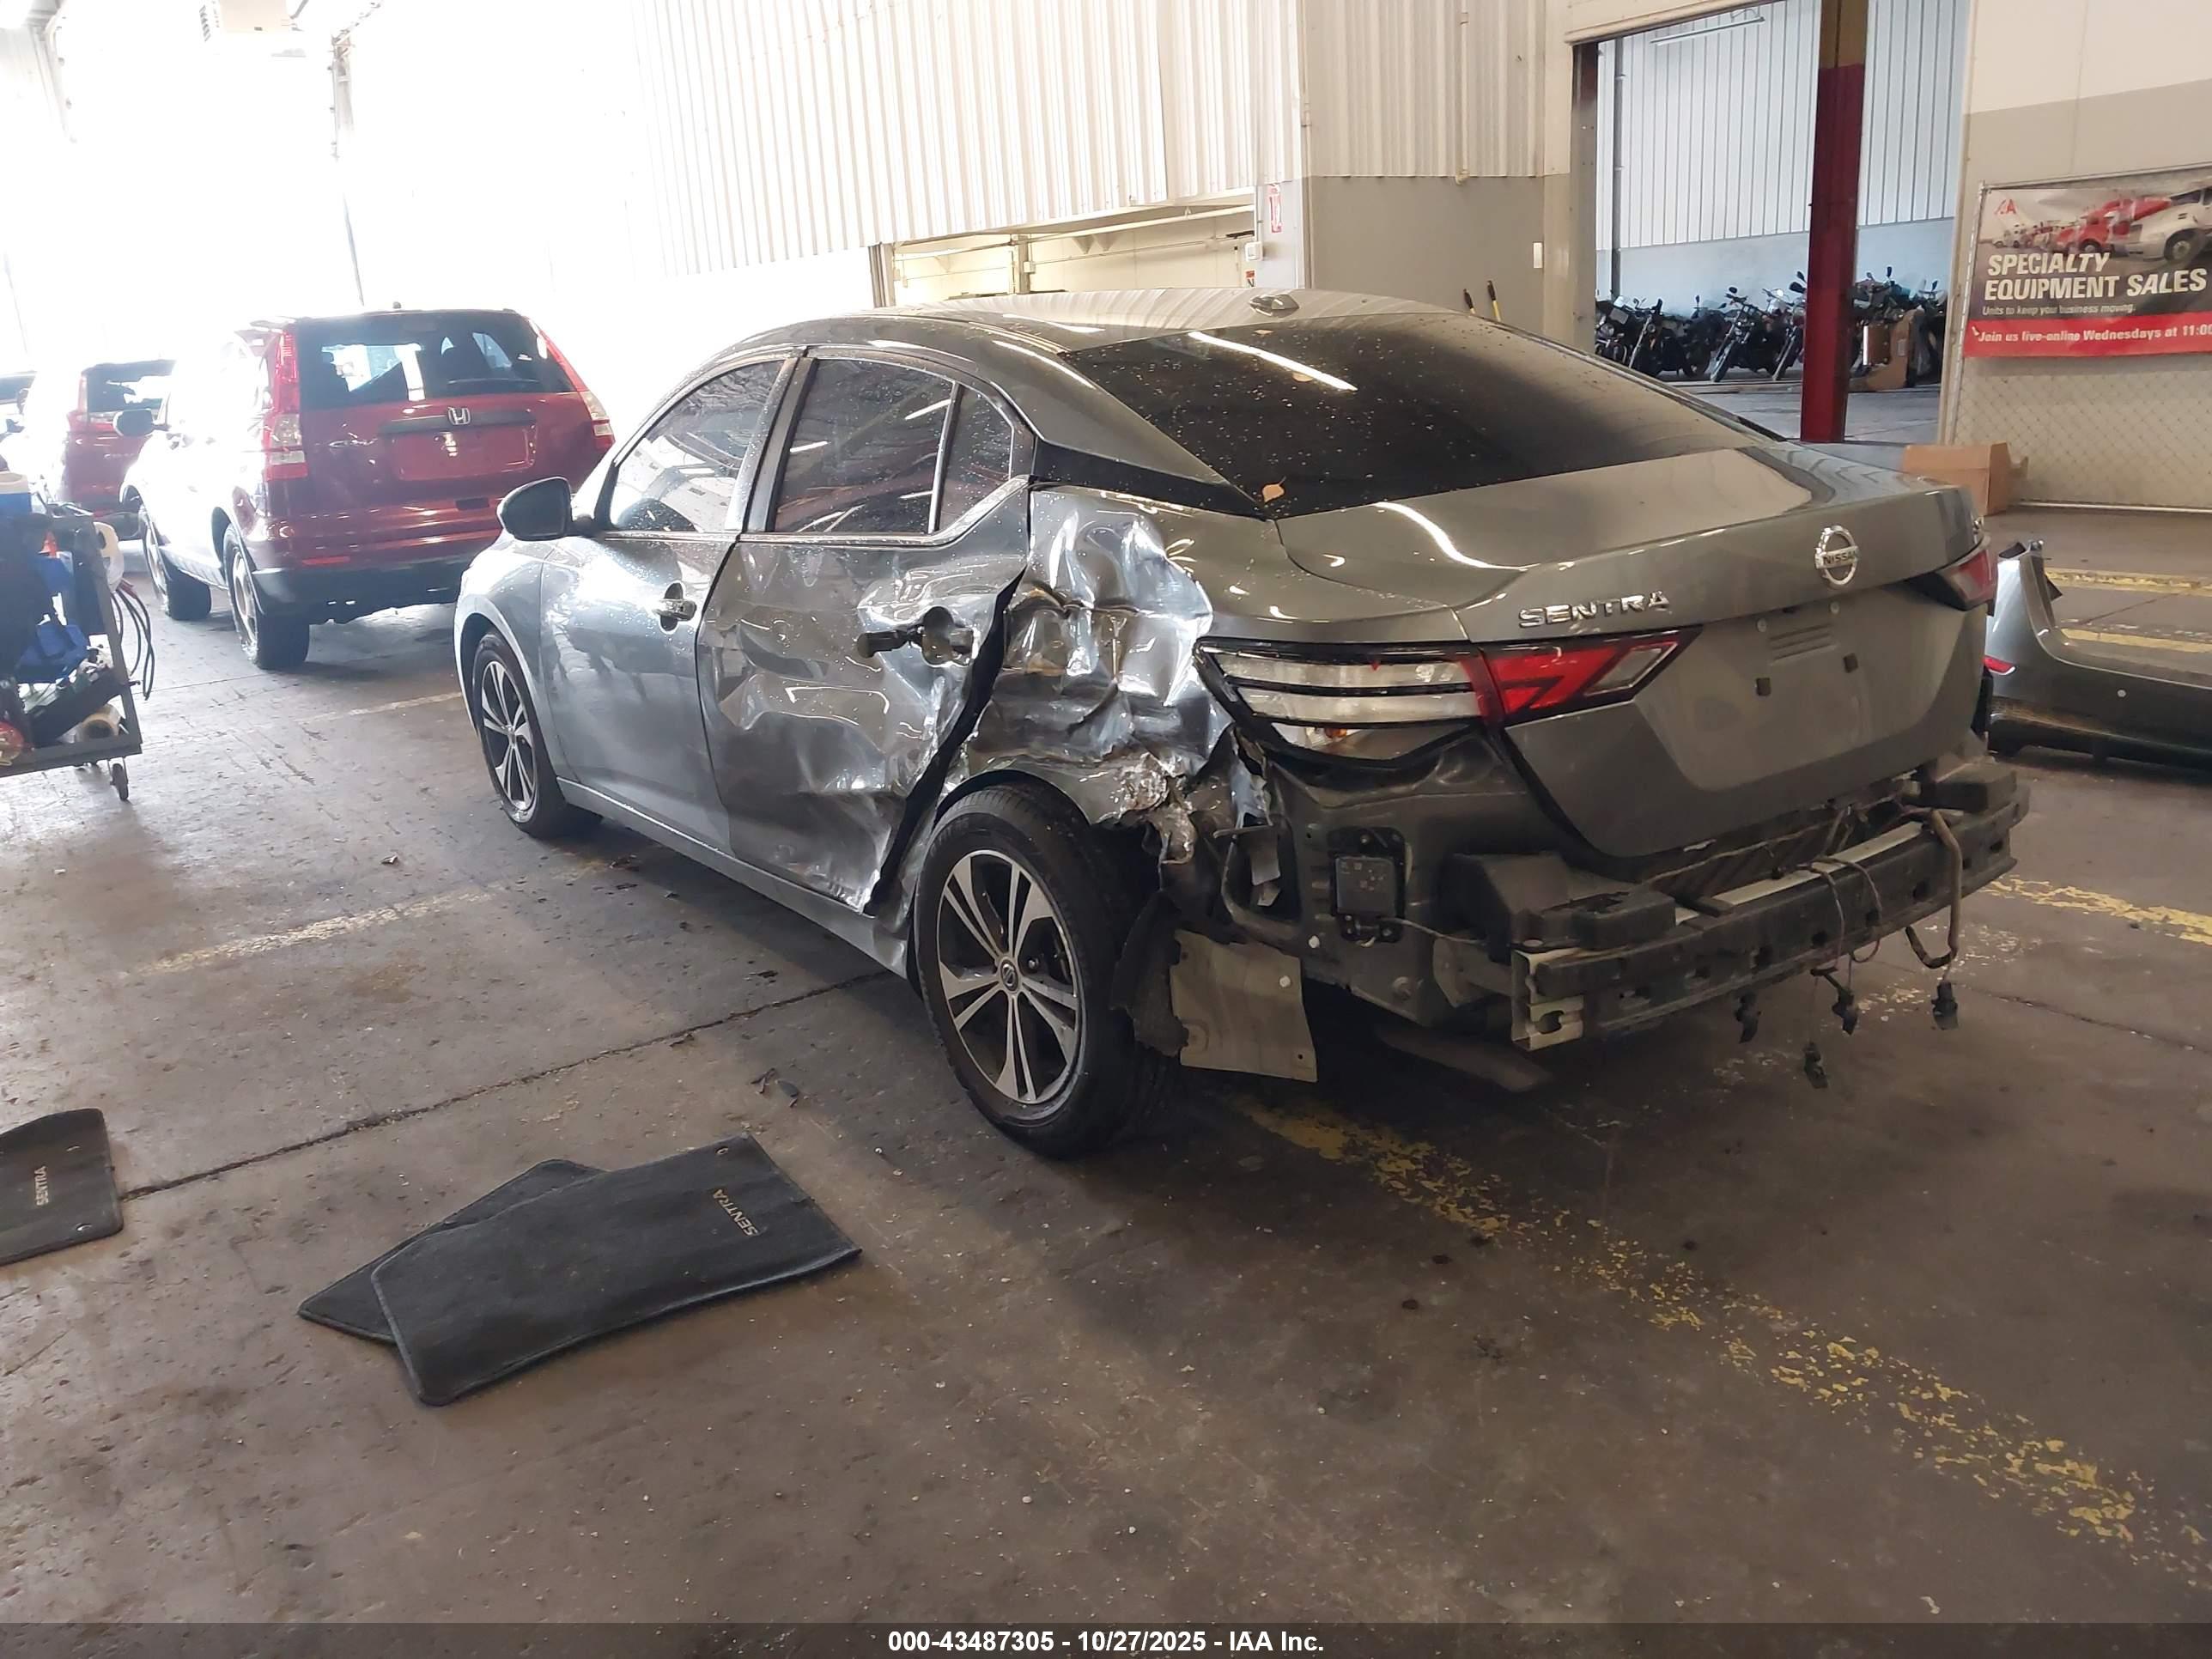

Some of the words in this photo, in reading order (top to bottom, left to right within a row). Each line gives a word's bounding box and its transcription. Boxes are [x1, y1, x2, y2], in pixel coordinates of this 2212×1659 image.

[1988, 252, 2110, 276] SPECIALTY
[1984, 276, 2119, 301] EQUIPMENT
[2126, 268, 2208, 297] SALES
[1982, 306, 2004, 316] Units
[2006, 307, 2015, 315] to
[2017, 305, 2038, 316] keep
[2059, 304, 2100, 315] business
[1978, 331, 2002, 342] Join
[2005, 332, 2018, 342] us
[2021, 331, 2081, 342] live-online
[2083, 328, 2161, 342] Wednesdays
[2165, 327, 2178, 337] at
[1519, 590, 1670, 628] SENTRA
[34, 1165, 49, 1206] SENTRA
[713, 1188, 759, 1237] SENTRA
